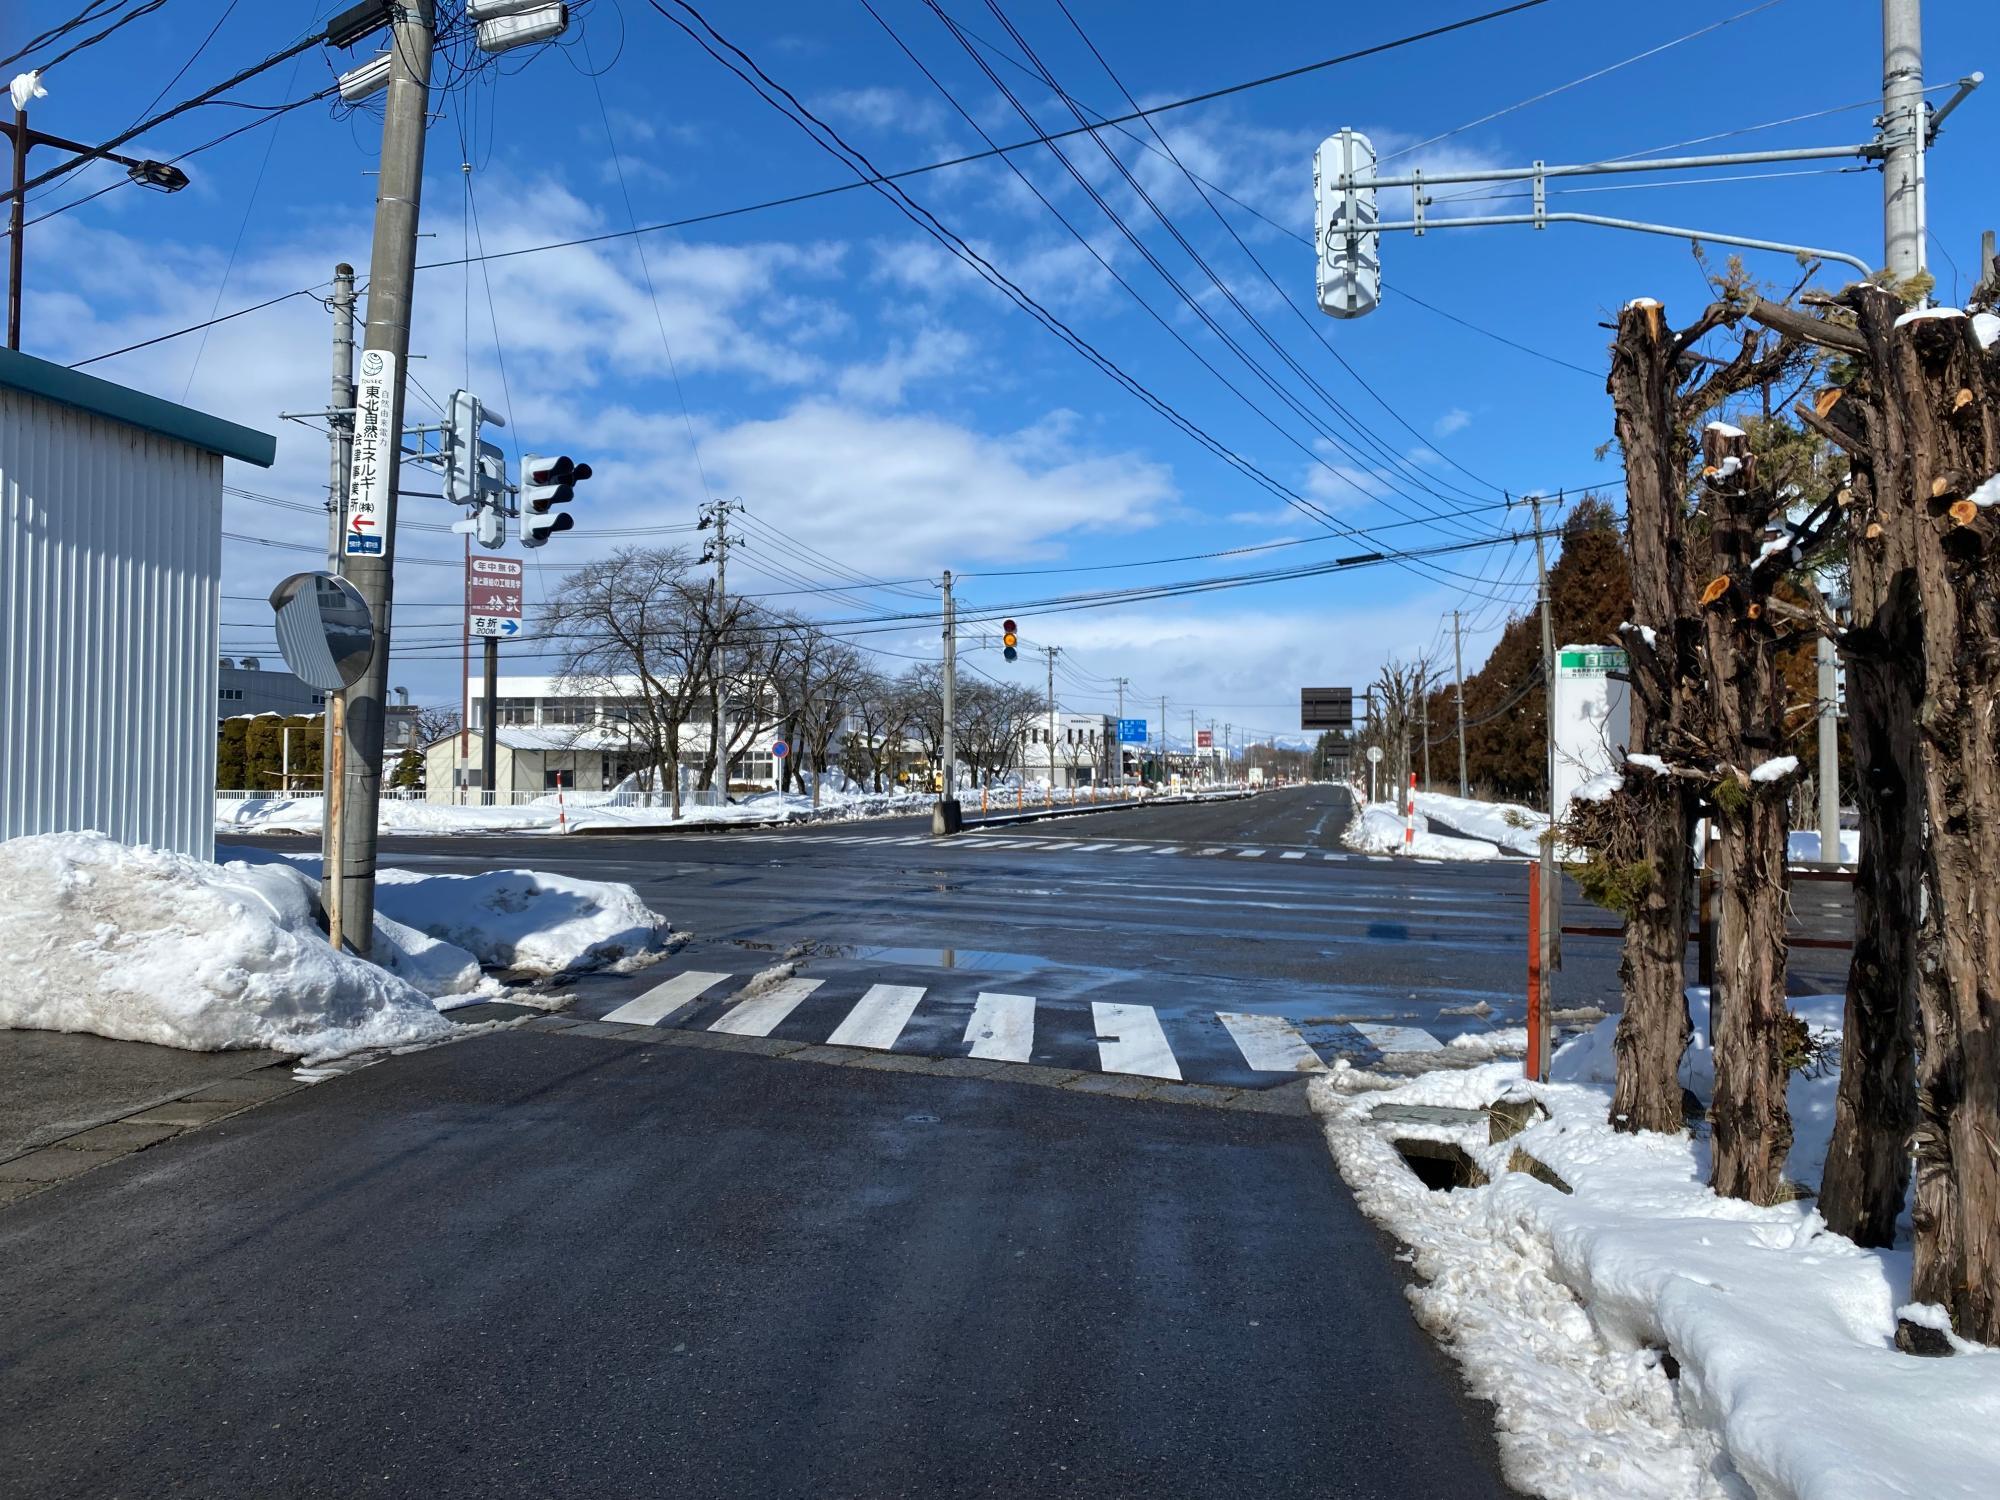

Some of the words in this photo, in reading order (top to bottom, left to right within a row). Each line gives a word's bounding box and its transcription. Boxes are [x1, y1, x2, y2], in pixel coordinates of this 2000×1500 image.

[477, 562, 517, 573] 年中無休
[475, 617, 498, 628] 右折
